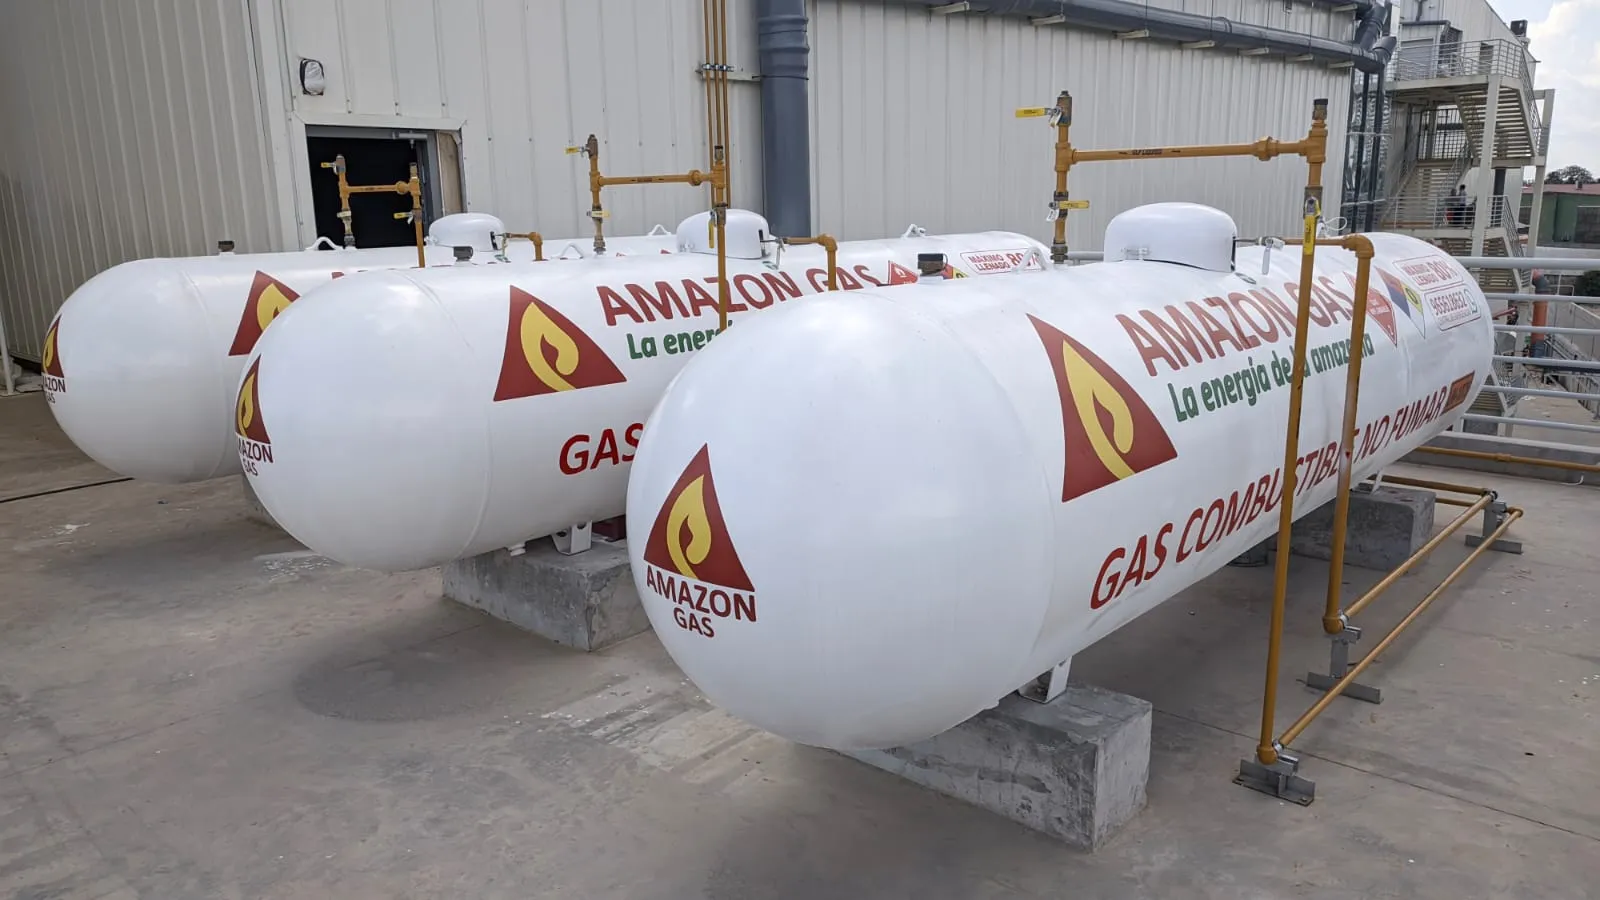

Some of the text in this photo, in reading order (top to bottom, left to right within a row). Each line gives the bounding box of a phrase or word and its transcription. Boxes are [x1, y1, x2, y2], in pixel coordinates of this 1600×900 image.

[596, 265, 882, 326] AMAZON GAS
[626, 333, 656, 359] La
[1115, 287, 1298, 376] AMAZON
[1283, 276, 1354, 328] GAS
[1167, 382, 1199, 422] La
[1200, 354, 1272, 406] energía
[1271, 349, 1294, 388] de
[559, 423, 644, 475] GAS
[1090, 385, 1448, 610] GAS COMBUSTIBL NO FUMAR
[646, 564, 757, 623] AMAZON
[673, 607, 715, 638] GAS
